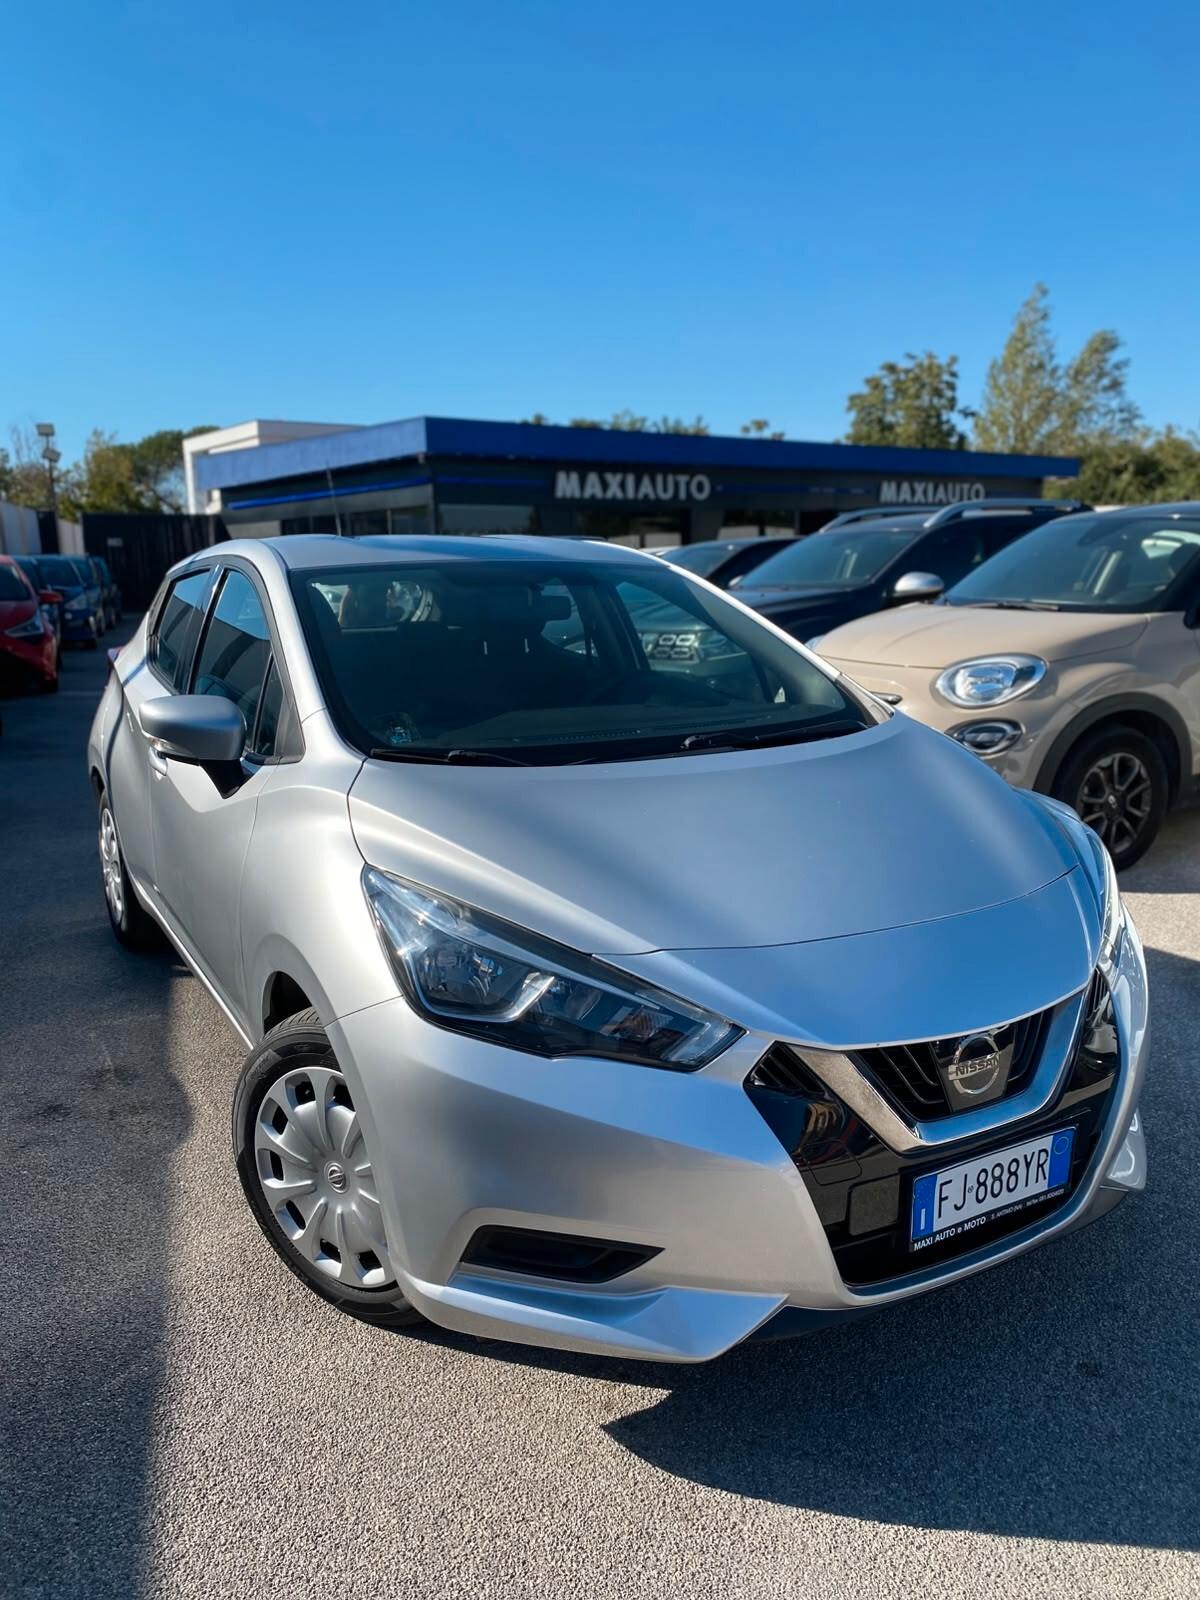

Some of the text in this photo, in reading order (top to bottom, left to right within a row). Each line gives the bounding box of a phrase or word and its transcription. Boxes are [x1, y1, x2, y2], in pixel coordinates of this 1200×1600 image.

[555, 470, 711, 500] MAXIAUTO
[880, 480, 985, 503] MAXIAUTO
[956, 1055, 999, 1076] NISSAN
[914, 1236, 933, 1251] MAXI
[934, 1228, 956, 1243] AUTO
[963, 1216, 987, 1231] MOTO
